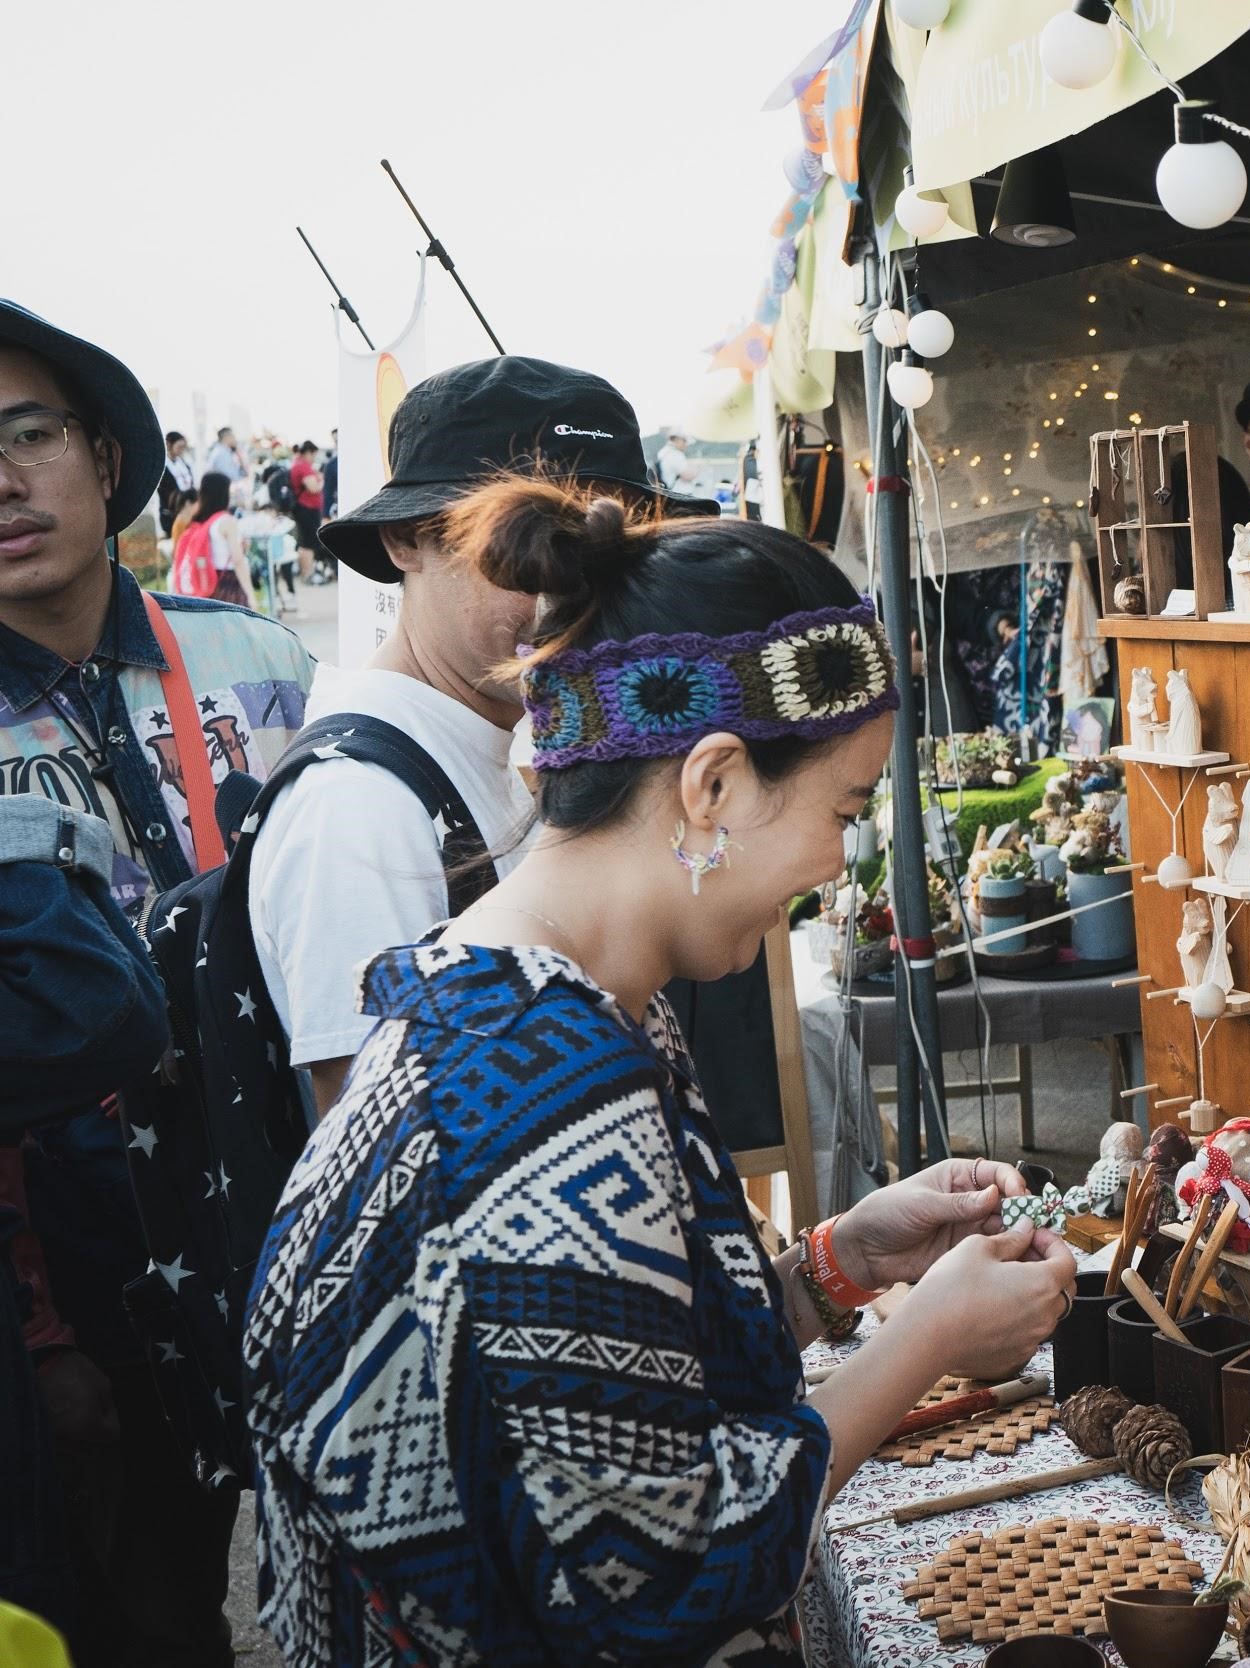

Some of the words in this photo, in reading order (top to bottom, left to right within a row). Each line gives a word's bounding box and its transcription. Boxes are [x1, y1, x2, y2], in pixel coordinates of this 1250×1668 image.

[554, 424, 614, 439] Champion
[375, 588, 402, 617] 沒有
[815, 1228, 838, 1283] Festival
